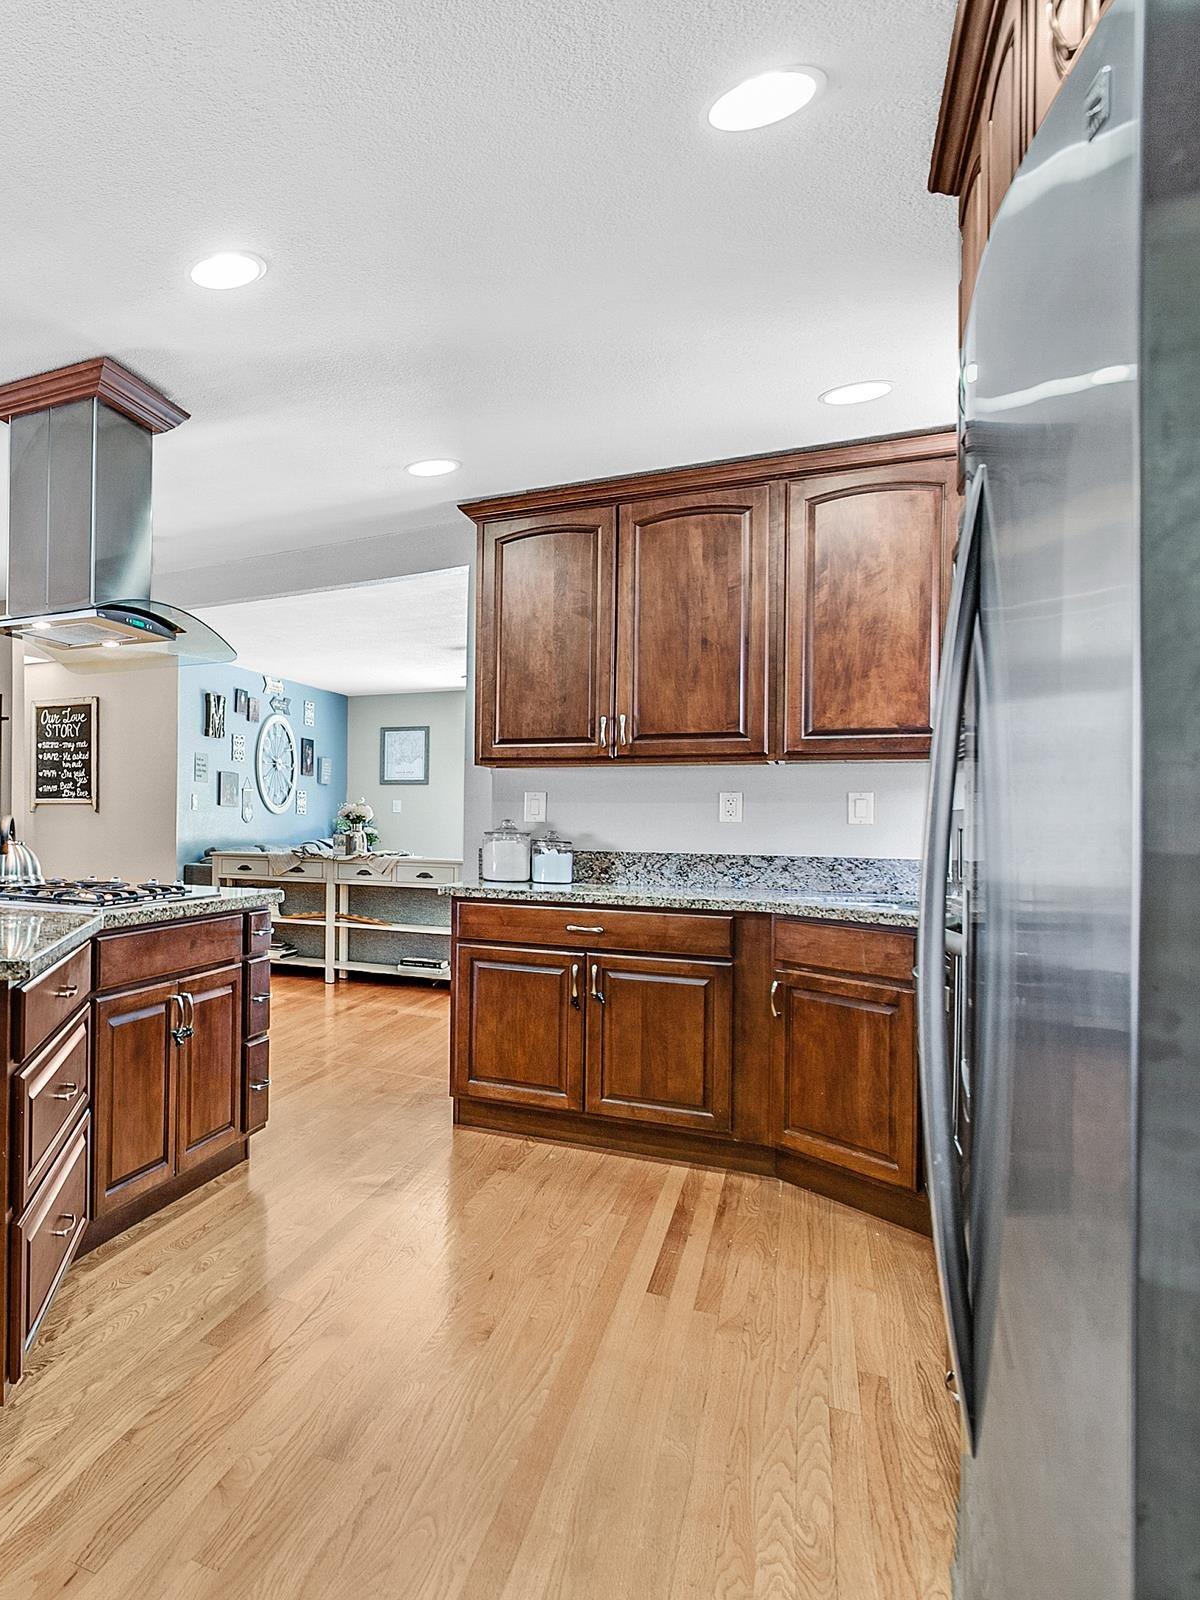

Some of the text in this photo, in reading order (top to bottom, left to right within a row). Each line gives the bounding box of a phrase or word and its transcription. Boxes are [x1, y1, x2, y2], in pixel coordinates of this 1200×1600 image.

[41, 707, 87, 724] Our Love
[45, 722, 81, 738] STORY
